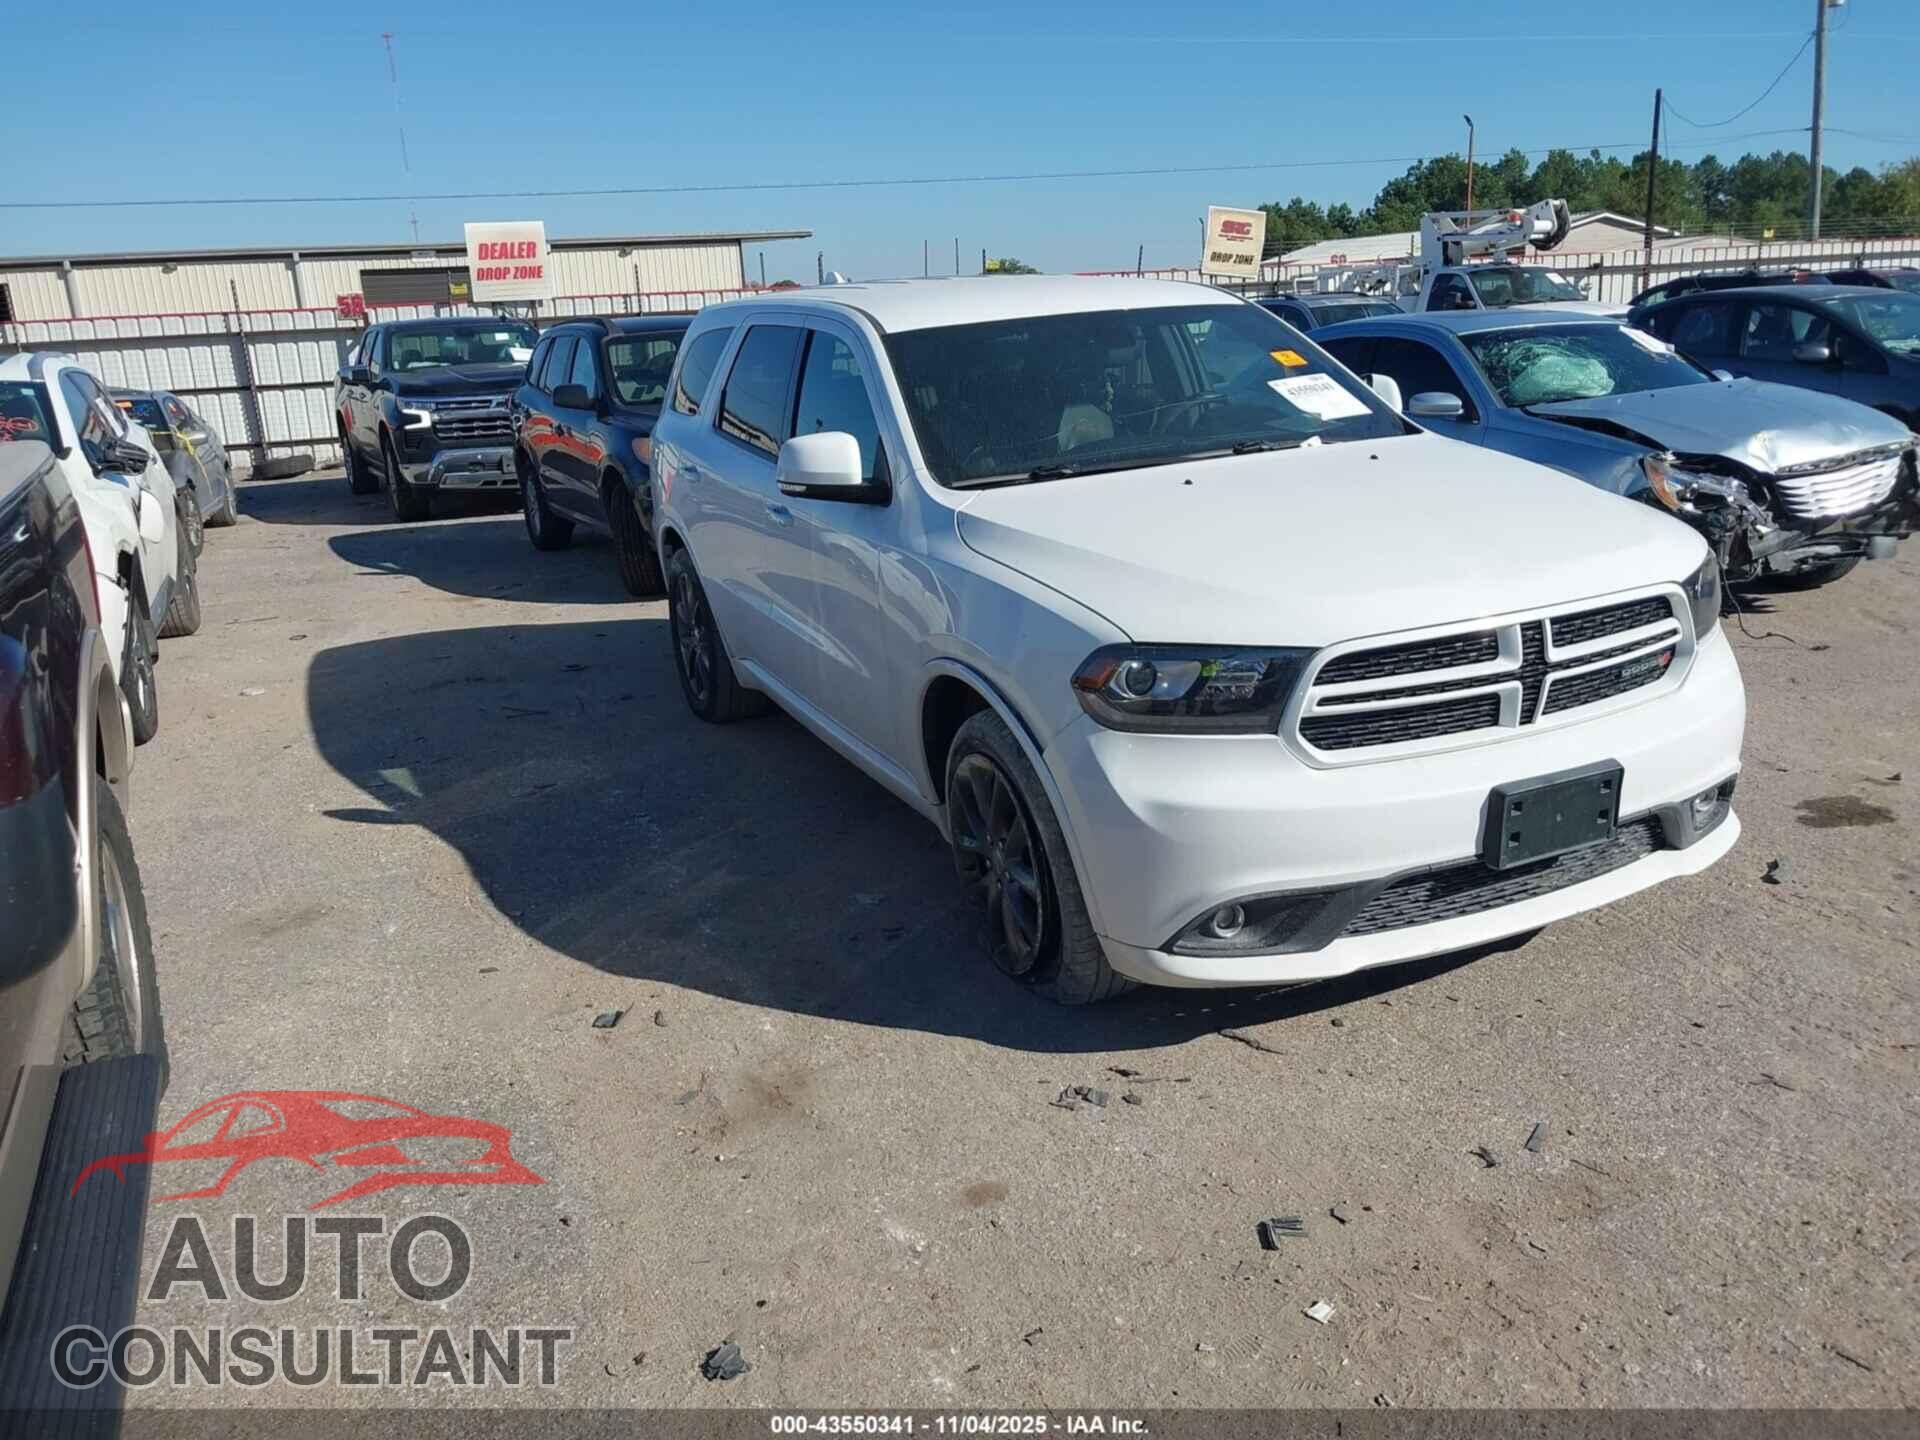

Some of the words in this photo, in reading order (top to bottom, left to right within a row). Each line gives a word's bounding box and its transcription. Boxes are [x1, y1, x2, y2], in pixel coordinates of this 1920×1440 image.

[478, 242, 537, 260] DEALER
[1210, 251, 1233, 264] DROP
[1233, 254, 1255, 266] ZONE
[476, 267, 511, 281] DROP
[513, 265, 543, 280] ZONE
